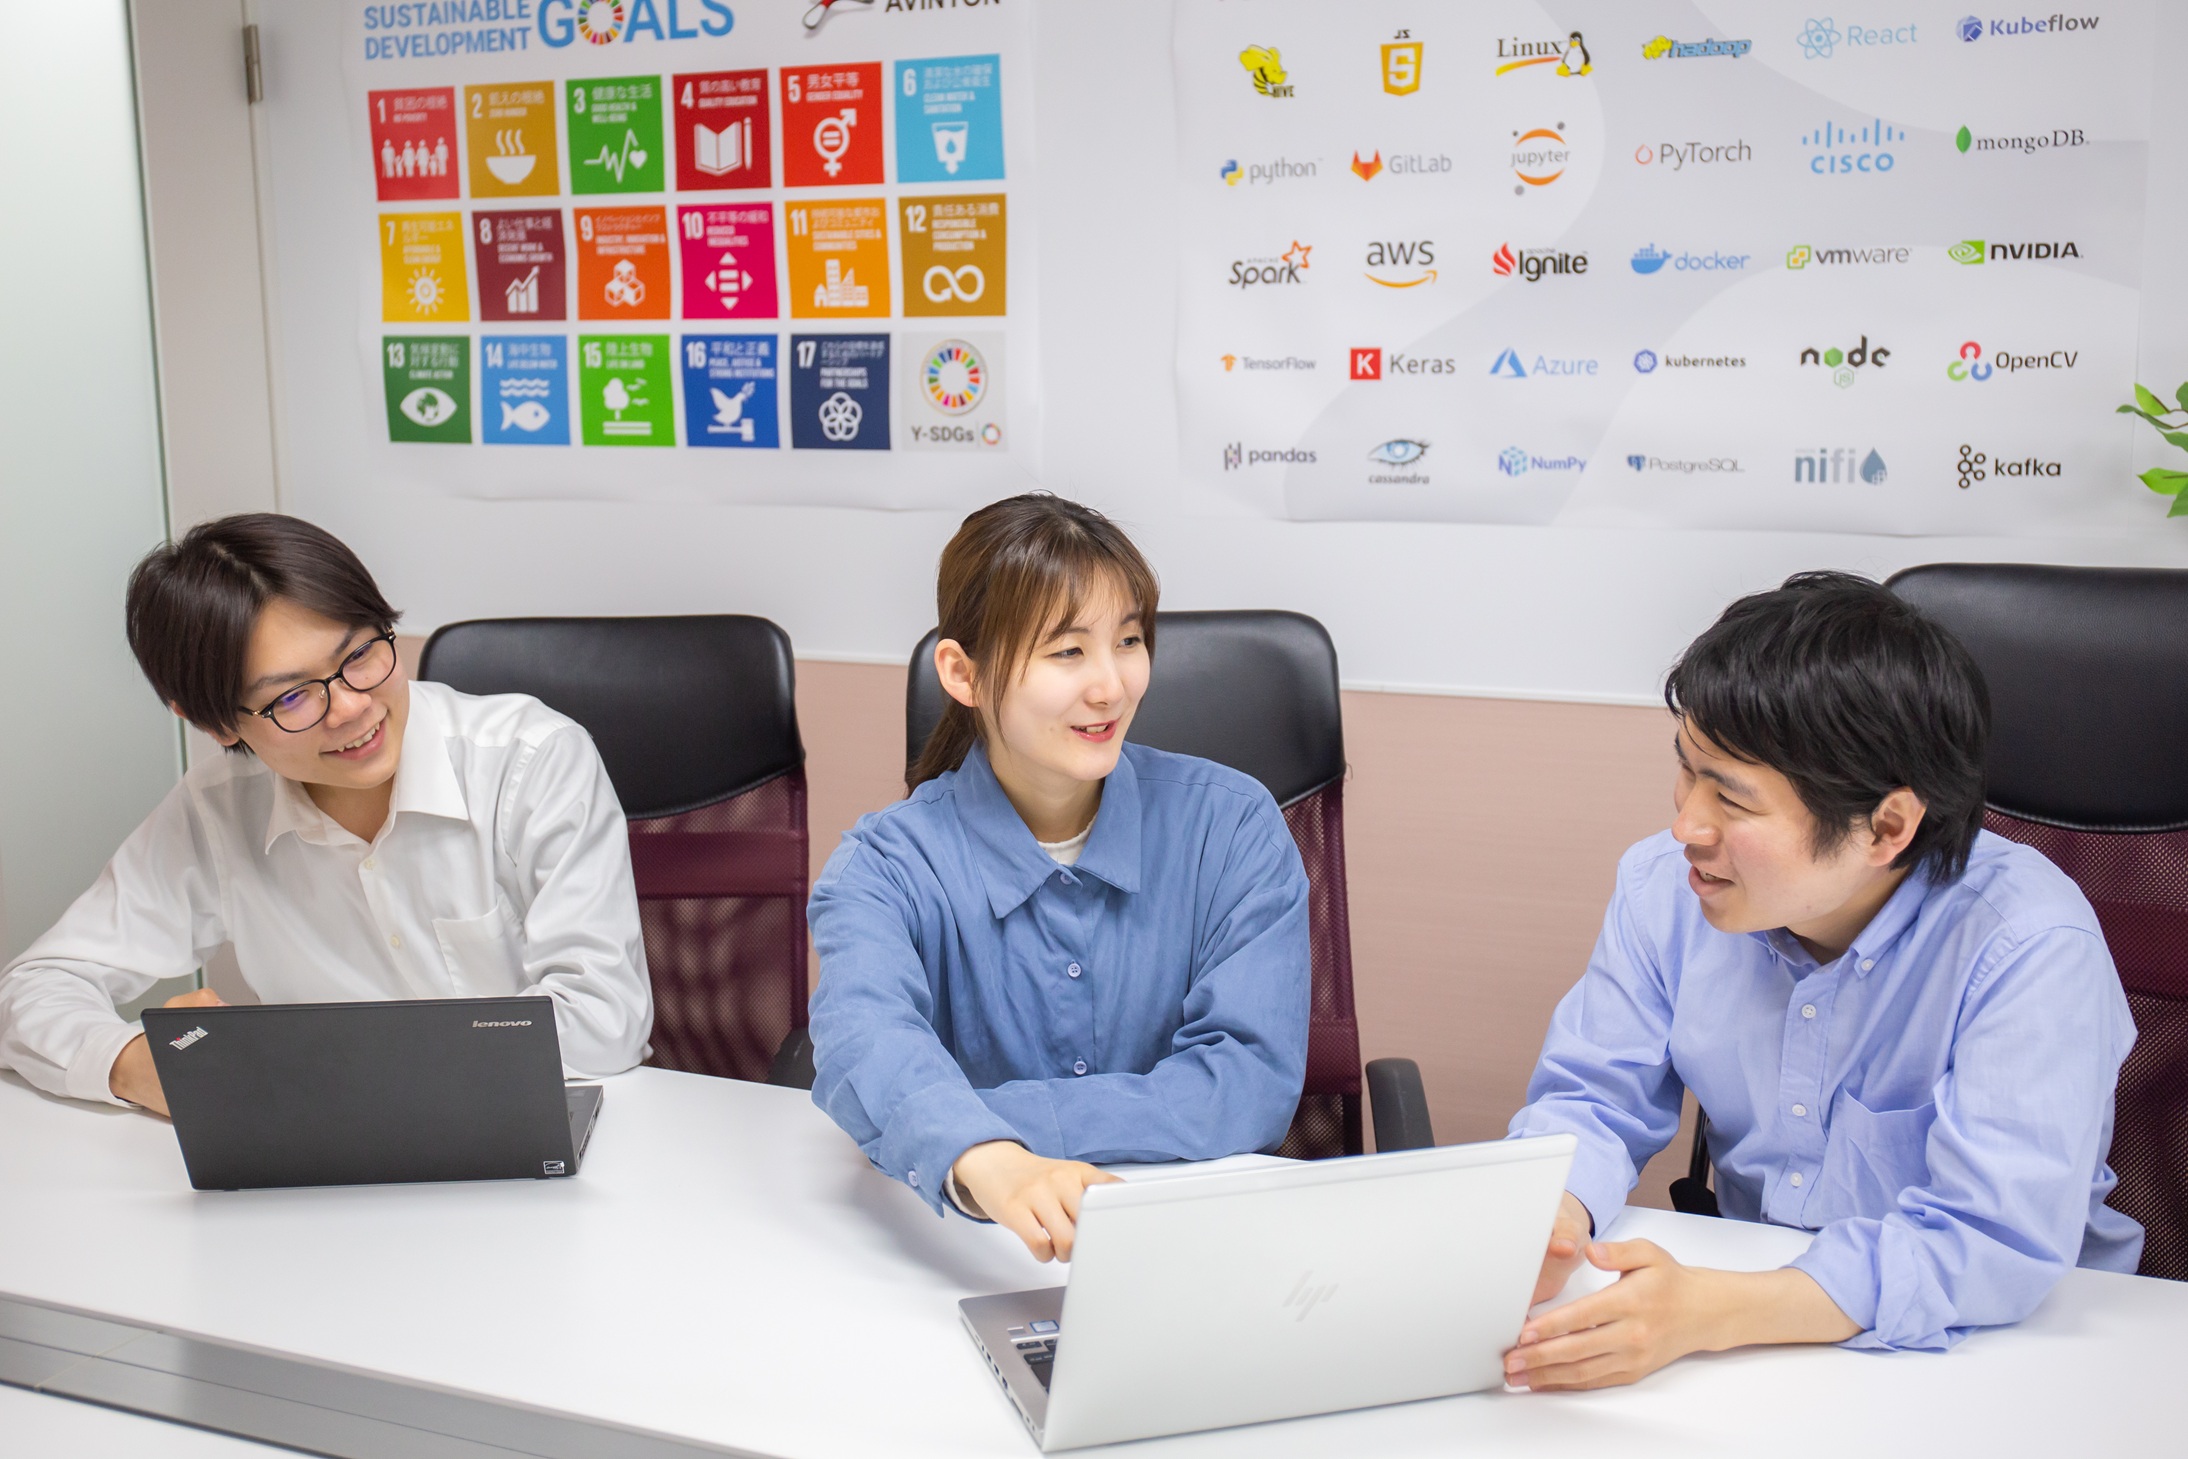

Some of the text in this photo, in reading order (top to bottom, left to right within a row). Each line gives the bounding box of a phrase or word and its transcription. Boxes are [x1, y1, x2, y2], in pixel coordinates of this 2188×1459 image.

[364, 0, 531, 30] SUSTAINABLE
[886, 0, 1000, 13] AVIN
[537, 0, 735, 49] GOALS
[1847, 24, 1917, 46] React
[1990, 14, 2099, 37] Kubeflow
[366, 27, 532, 60] DEVELOPMENT
[1497, 37, 1563, 58] Linux
[1668, 38, 1752, 58] hadoop
[592, 82, 653, 101] 健康な生活
[788, 75, 801, 103] 5
[806, 71, 860, 90] 男女平等
[903, 68, 917, 96] 6
[1272, 85, 1294, 98] HIVE
[472, 92, 483, 119] 2
[573, 87, 586, 114] 3
[681, 81, 694, 109] 4
[377, 97, 386, 125] 1
[1660, 138, 1751, 171] PyTorch
[1976, 129, 2085, 155] mongoDB
[1249, 157, 1316, 184] python
[1389, 154, 1453, 174] GitLab
[1510, 149, 1570, 168] jupyter
[1810, 153, 1894, 174] CISCO
[905, 204, 927, 232] 12
[932, 201, 1000, 218] 責任ある消費
[386, 220, 396, 246] 7
[479, 218, 493, 244] 8
[580, 215, 594, 242] 9
[682, 211, 704, 240] 10
[790, 208, 808, 237] 11
[1367, 240, 1434, 267] aws
[1519, 250, 1588, 282] Ignite
[1675, 251, 1751, 271] docker
[1815, 247, 1909, 265] vmware
[1229, 260, 1301, 290] Spark
[387, 342, 406, 369] 13
[485, 342, 504, 369] 14
[583, 341, 602, 369] 15
[686, 341, 707, 369] 16
[710, 341, 770, 358] 平和と正義
[797, 341, 817, 369] 17
[1665, 355, 1746, 368] kubernetes
[1996, 351, 2078, 373] OpenCV
[1242, 356, 1316, 370] TensorFlow
[1390, 353, 1456, 374] Keras
[1532, 354, 1599, 376] Azure
[911, 426, 974, 442] Y-SDGs
[1249, 447, 1317, 466] pandas
[1532, 456, 1586, 473] NumPy
[1650, 457, 1744, 474] PostgreSQL
[1795, 448, 1856, 483] nifi
[1995, 458, 2061, 477] kafka
[1368, 473, 1429, 485] cassandra
[472, 1020, 532, 1028] lenovo
[169, 1026, 209, 1051] ThinkPad
